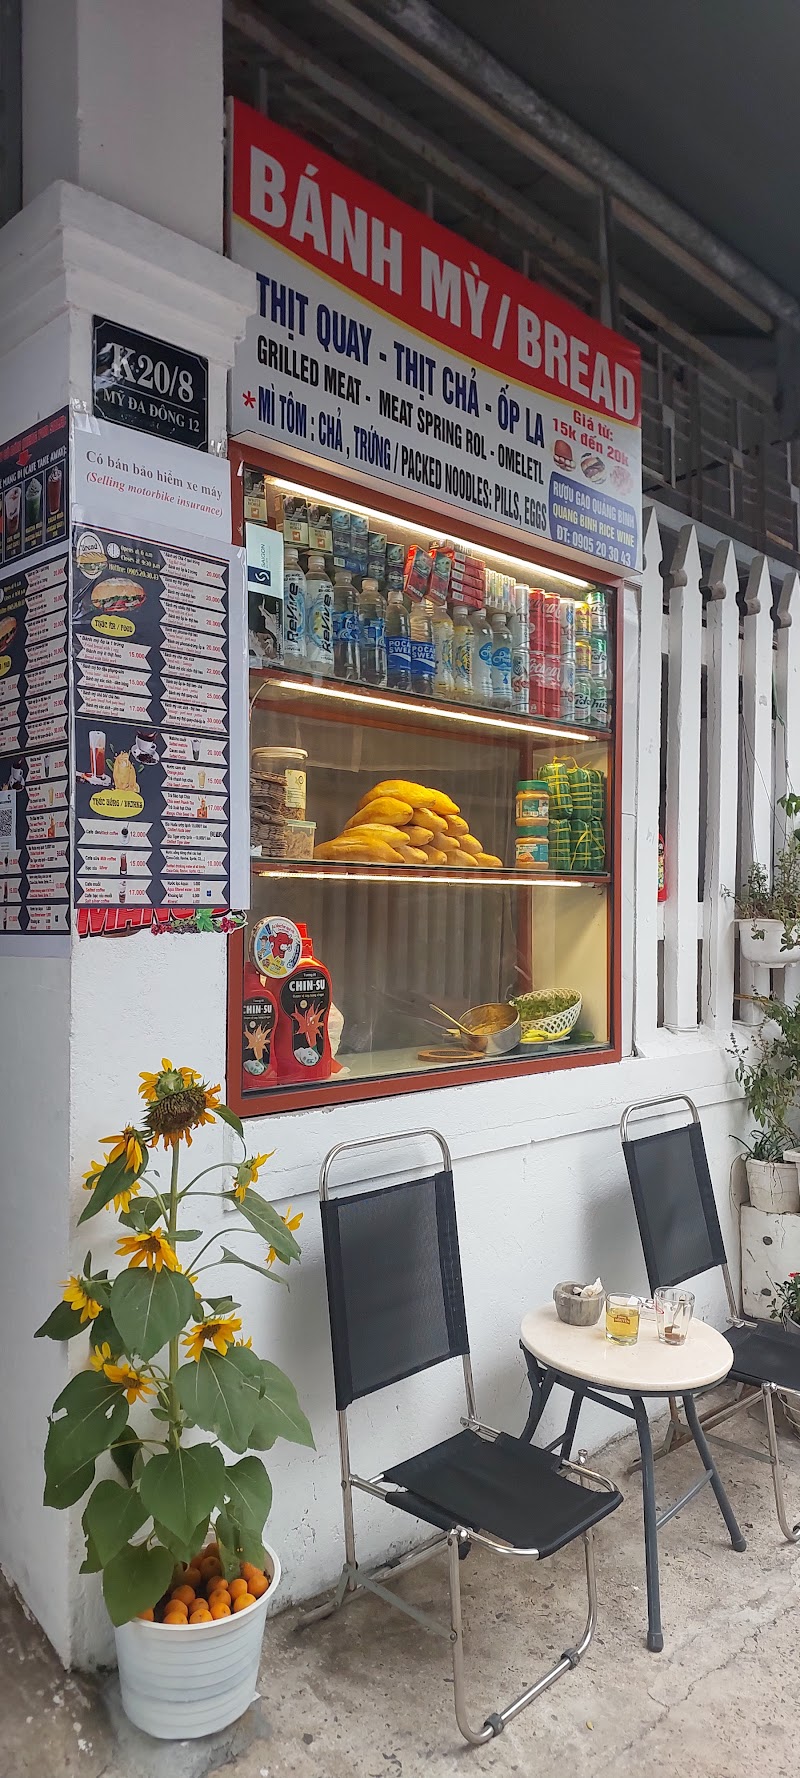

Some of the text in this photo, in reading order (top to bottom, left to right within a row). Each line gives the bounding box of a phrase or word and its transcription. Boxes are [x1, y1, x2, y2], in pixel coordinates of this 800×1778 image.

[250, 145, 635, 420] BÁNH MỲ / BREAD
[110, 342, 194, 403] K20/8
[256, 272, 545, 448] THỊT QUAY - THỊT CHẢ - ỐP LA
[103, 387, 200, 433] MỸ ĐA ĐÔNG 12
[257, 334, 319, 387] GRILLED
[324, 364, 361, 405] MEAT
[379, 389, 414, 428] MEAT
[416, 407, 462, 449] SPRING
[466, 428, 487, 460] ROL
[498, 443, 544, 485] OMELETL
[573, 409, 613, 441] Giá từ:
[258, 383, 275, 426] MÌ
[279, 391, 307, 438] TÔM
[318, 407, 343, 452] CHẢ
[353, 425, 391, 471] TRỨNG
[393, 442, 399, 474] /
[401, 445, 442, 490] PACKED
[445, 463, 492, 509] NOODLES:
[494, 483, 521, 525] PILLS,
[524, 496, 547, 532] EGGS
[552, 418, 629, 467] 15k đến 20k
[86, 450, 223, 500] Có bán bảo hiểm xe máy
[86, 470, 125, 492] (Selling
[127, 483, 175, 504] motorbike
[177, 495, 223, 518] insurance)
[552, 502, 579, 525] QUANG
[599, 522, 614, 540] RICE
[616, 530, 634, 548] WINE
[553, 480, 634, 529] RƯỢU GẠO QUẢNG BÌNH
[556, 524, 631, 566] ĐT: 0905 20 30 43
[128, 889, 145, 897] 17.000
[289, 979, 325, 992] CHIN-SU
